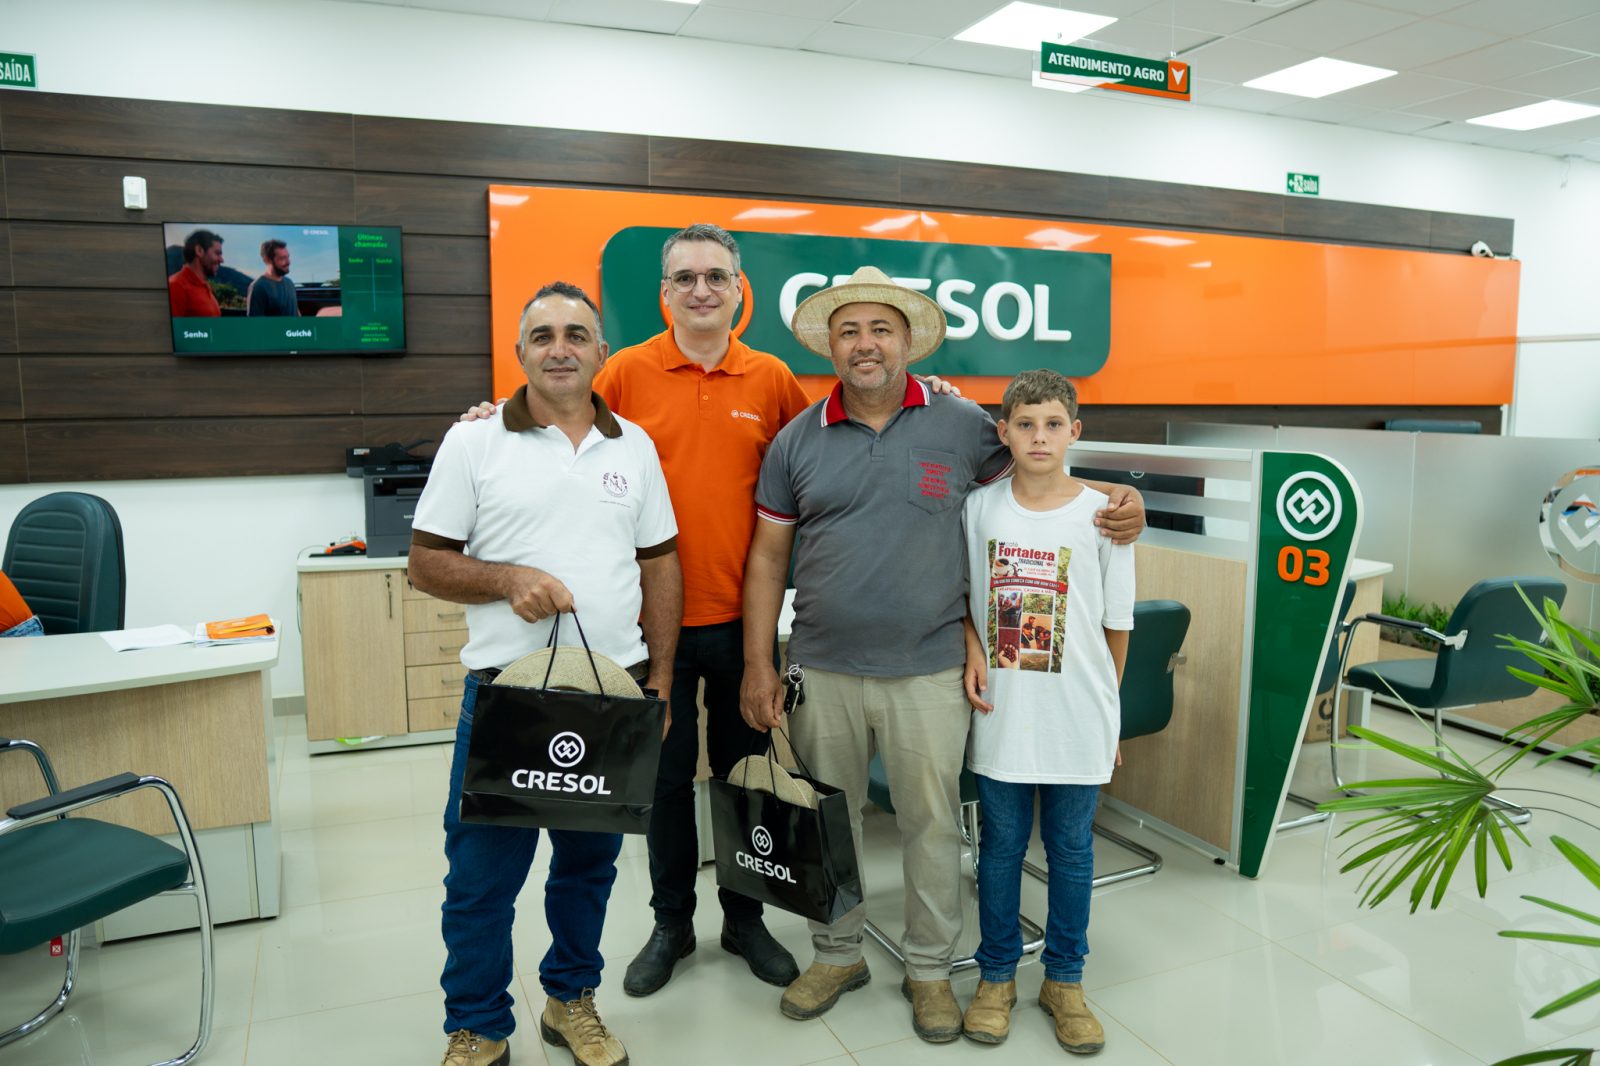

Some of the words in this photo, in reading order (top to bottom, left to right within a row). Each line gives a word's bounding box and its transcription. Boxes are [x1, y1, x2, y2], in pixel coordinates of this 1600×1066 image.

[1048, 52, 1132, 77] ATENDIMENTO
[1133, 66, 1165, 82] AGRO
[779, 272, 1072, 342] CSOL
[183, 330, 208, 339] Senha
[285, 329, 312, 339] Guichê
[998, 545, 1056, 562] Fortaleza
[1277, 545, 1331, 587] 03
[511, 769, 612, 796] CRESOL
[735, 851, 797, 884] CRESOL
